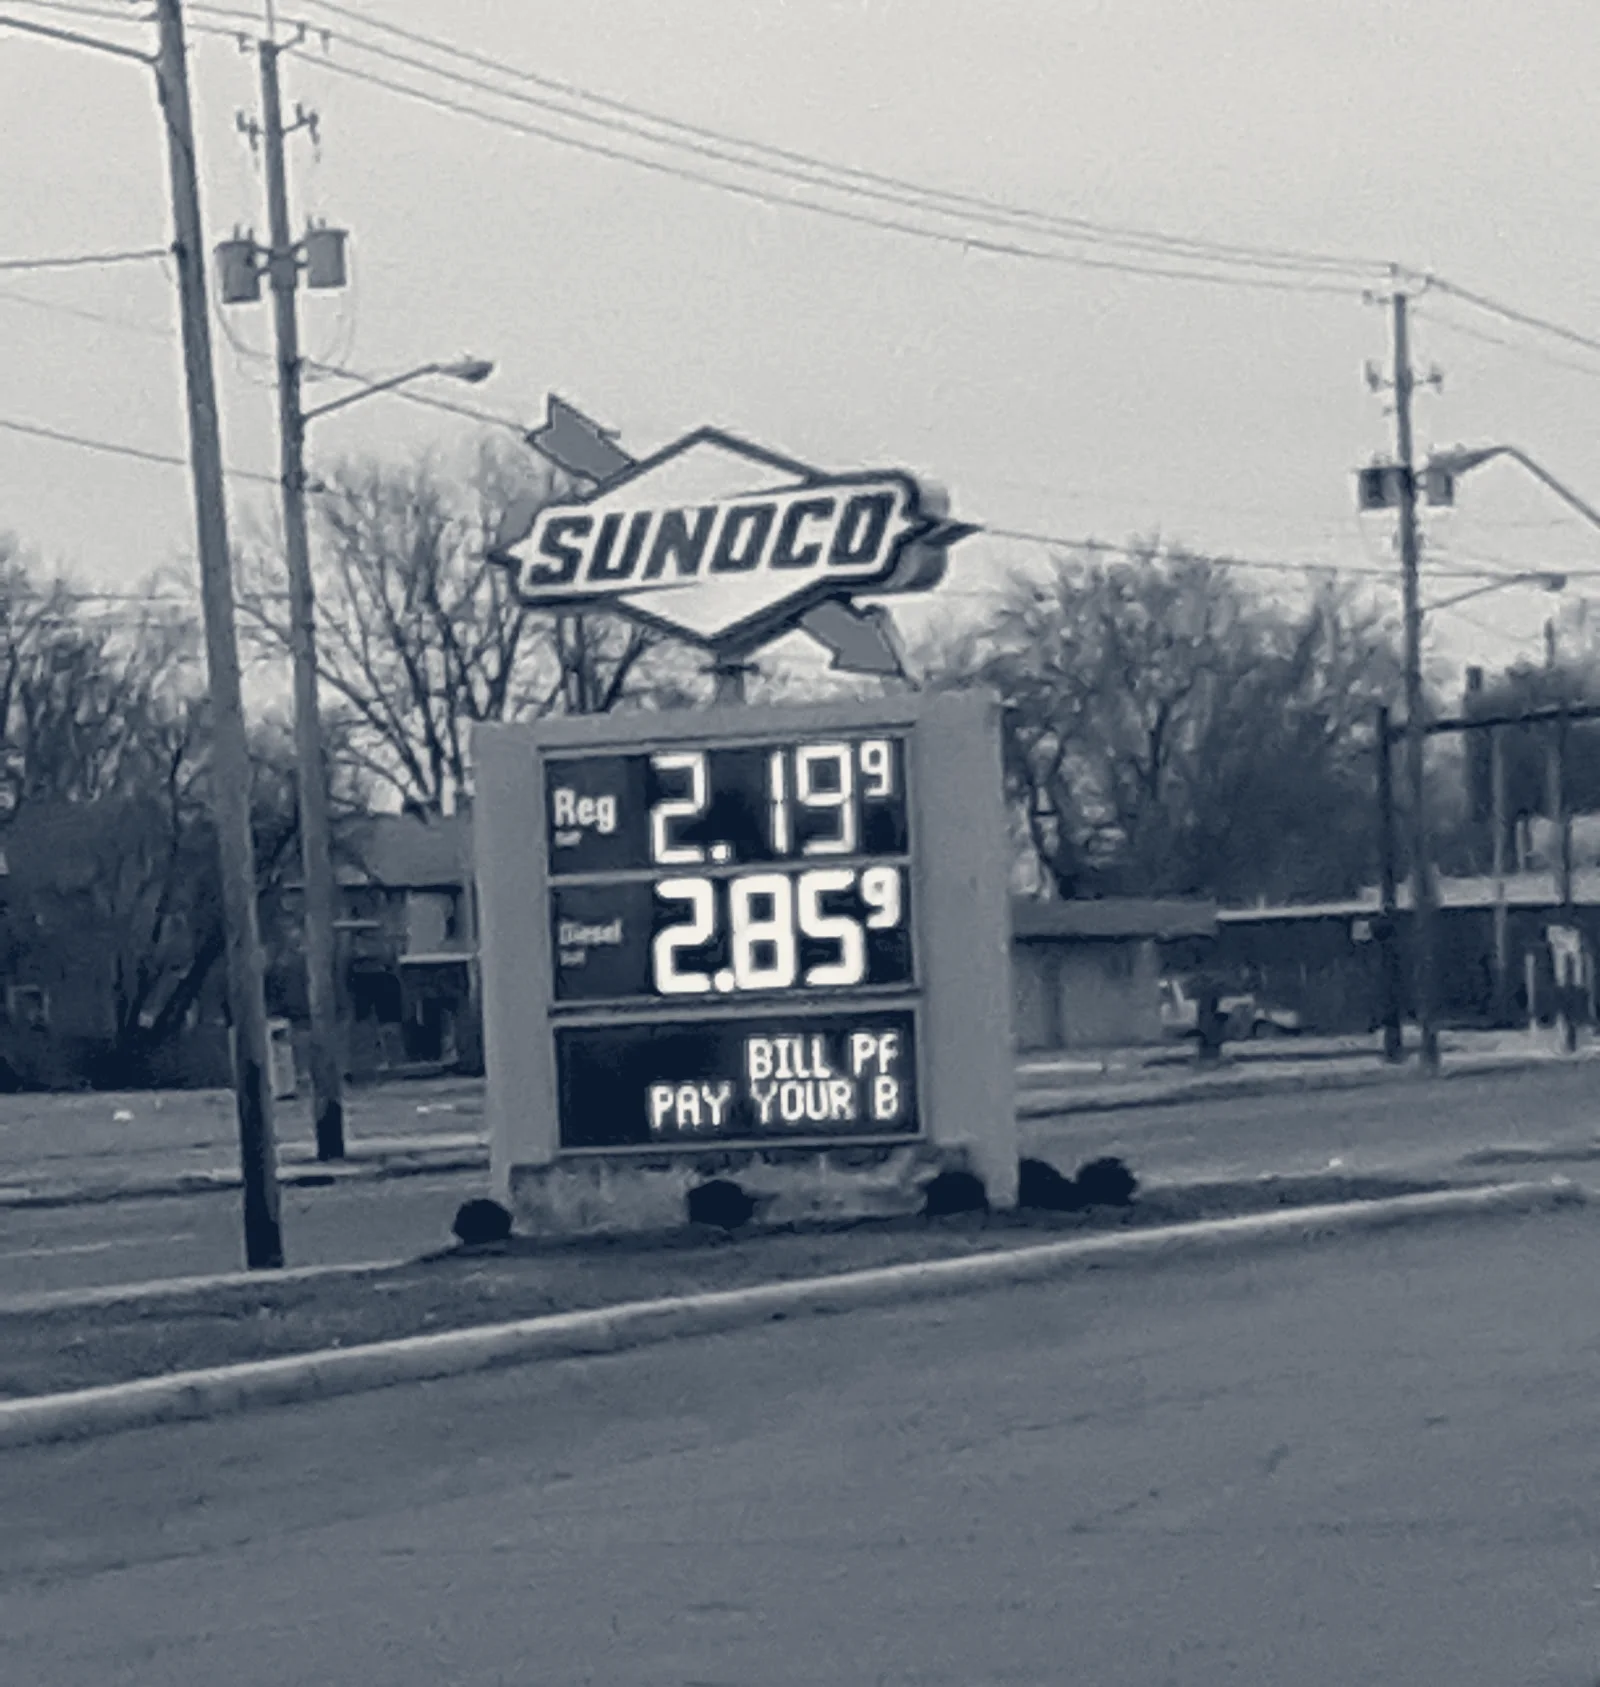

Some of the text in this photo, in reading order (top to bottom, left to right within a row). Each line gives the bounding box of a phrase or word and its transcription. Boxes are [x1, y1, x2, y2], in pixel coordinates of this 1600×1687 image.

[525, 490, 899, 586] SUNOCO
[553, 788, 617, 834] Reg
[748, 1036, 831, 1079] BILL
[650, 1074, 899, 1130] PAY YOUR B
